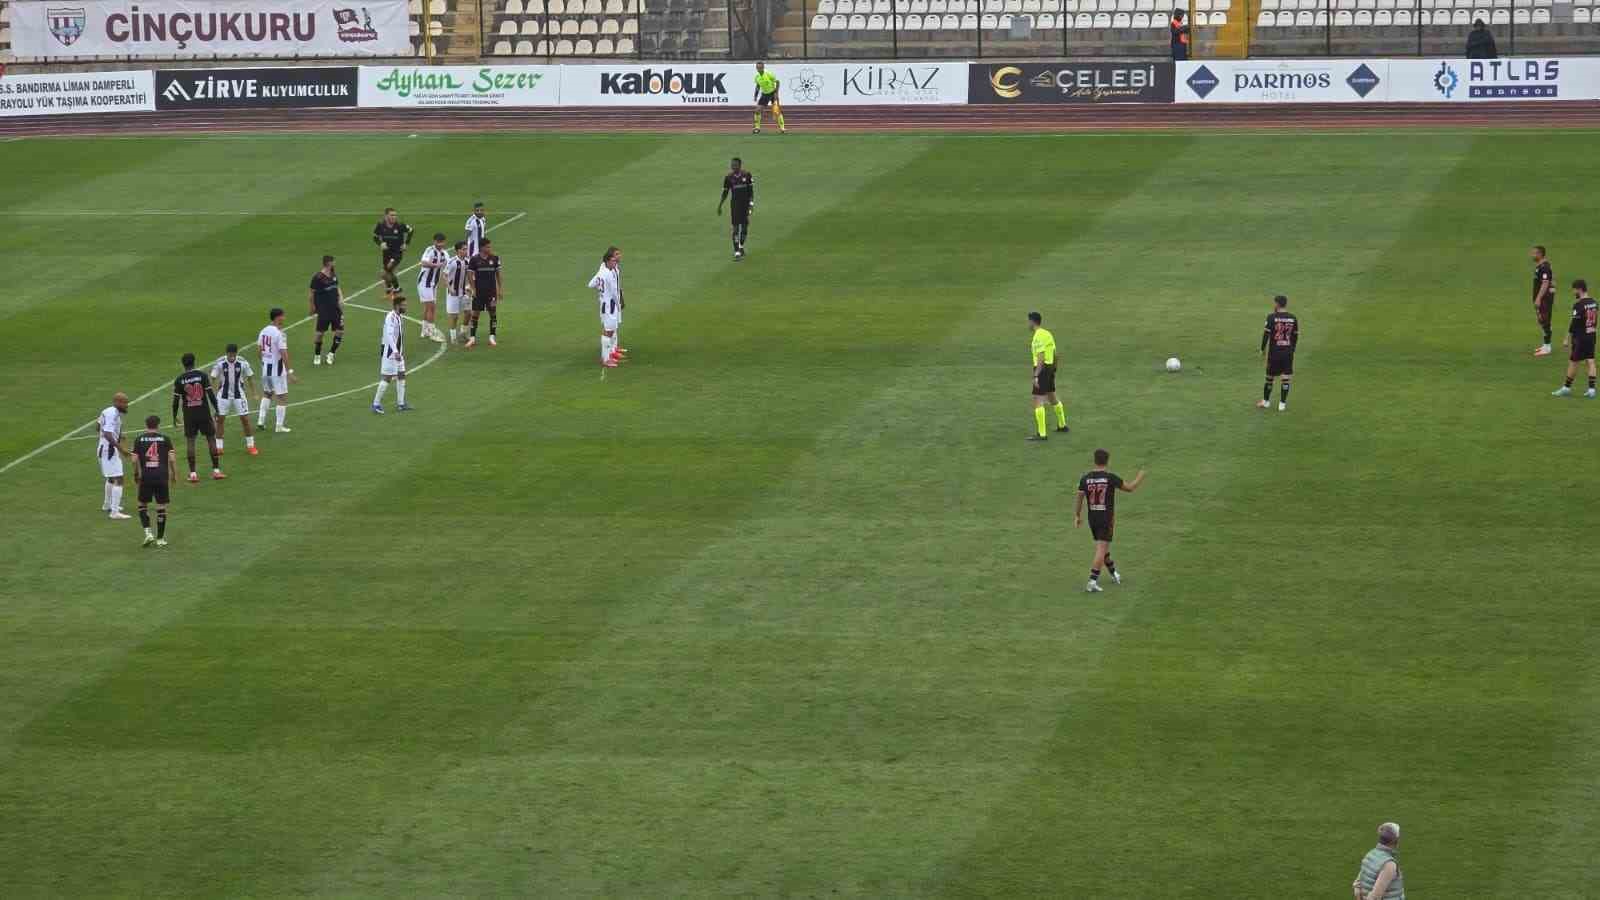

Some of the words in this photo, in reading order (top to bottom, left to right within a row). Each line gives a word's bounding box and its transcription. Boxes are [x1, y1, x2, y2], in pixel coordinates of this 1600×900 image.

[106, 6, 315, 49] CİNÇUKURU
[1055, 65, 1156, 94] ÇELEBİ
[1470, 61, 1560, 81] ATLAS
[16, 82, 61, 93] BANDIRMA
[63, 79, 90, 92] LİMAN
[193, 76, 257, 99] ZİRVE
[262, 84, 349, 97] KUYUMCULUK
[376, 67, 464, 97] Ayhan
[472, 68, 542, 92] Sezer
[0, 98, 34, 109] RAYOLU
[56, 95, 89, 110] TAŞIMA
[90, 92, 146, 106] KOOPERATİFİ
[681, 95, 729, 104] Yumurta
[261, 335, 273, 352] 14
[145, 441, 160, 461] 4
